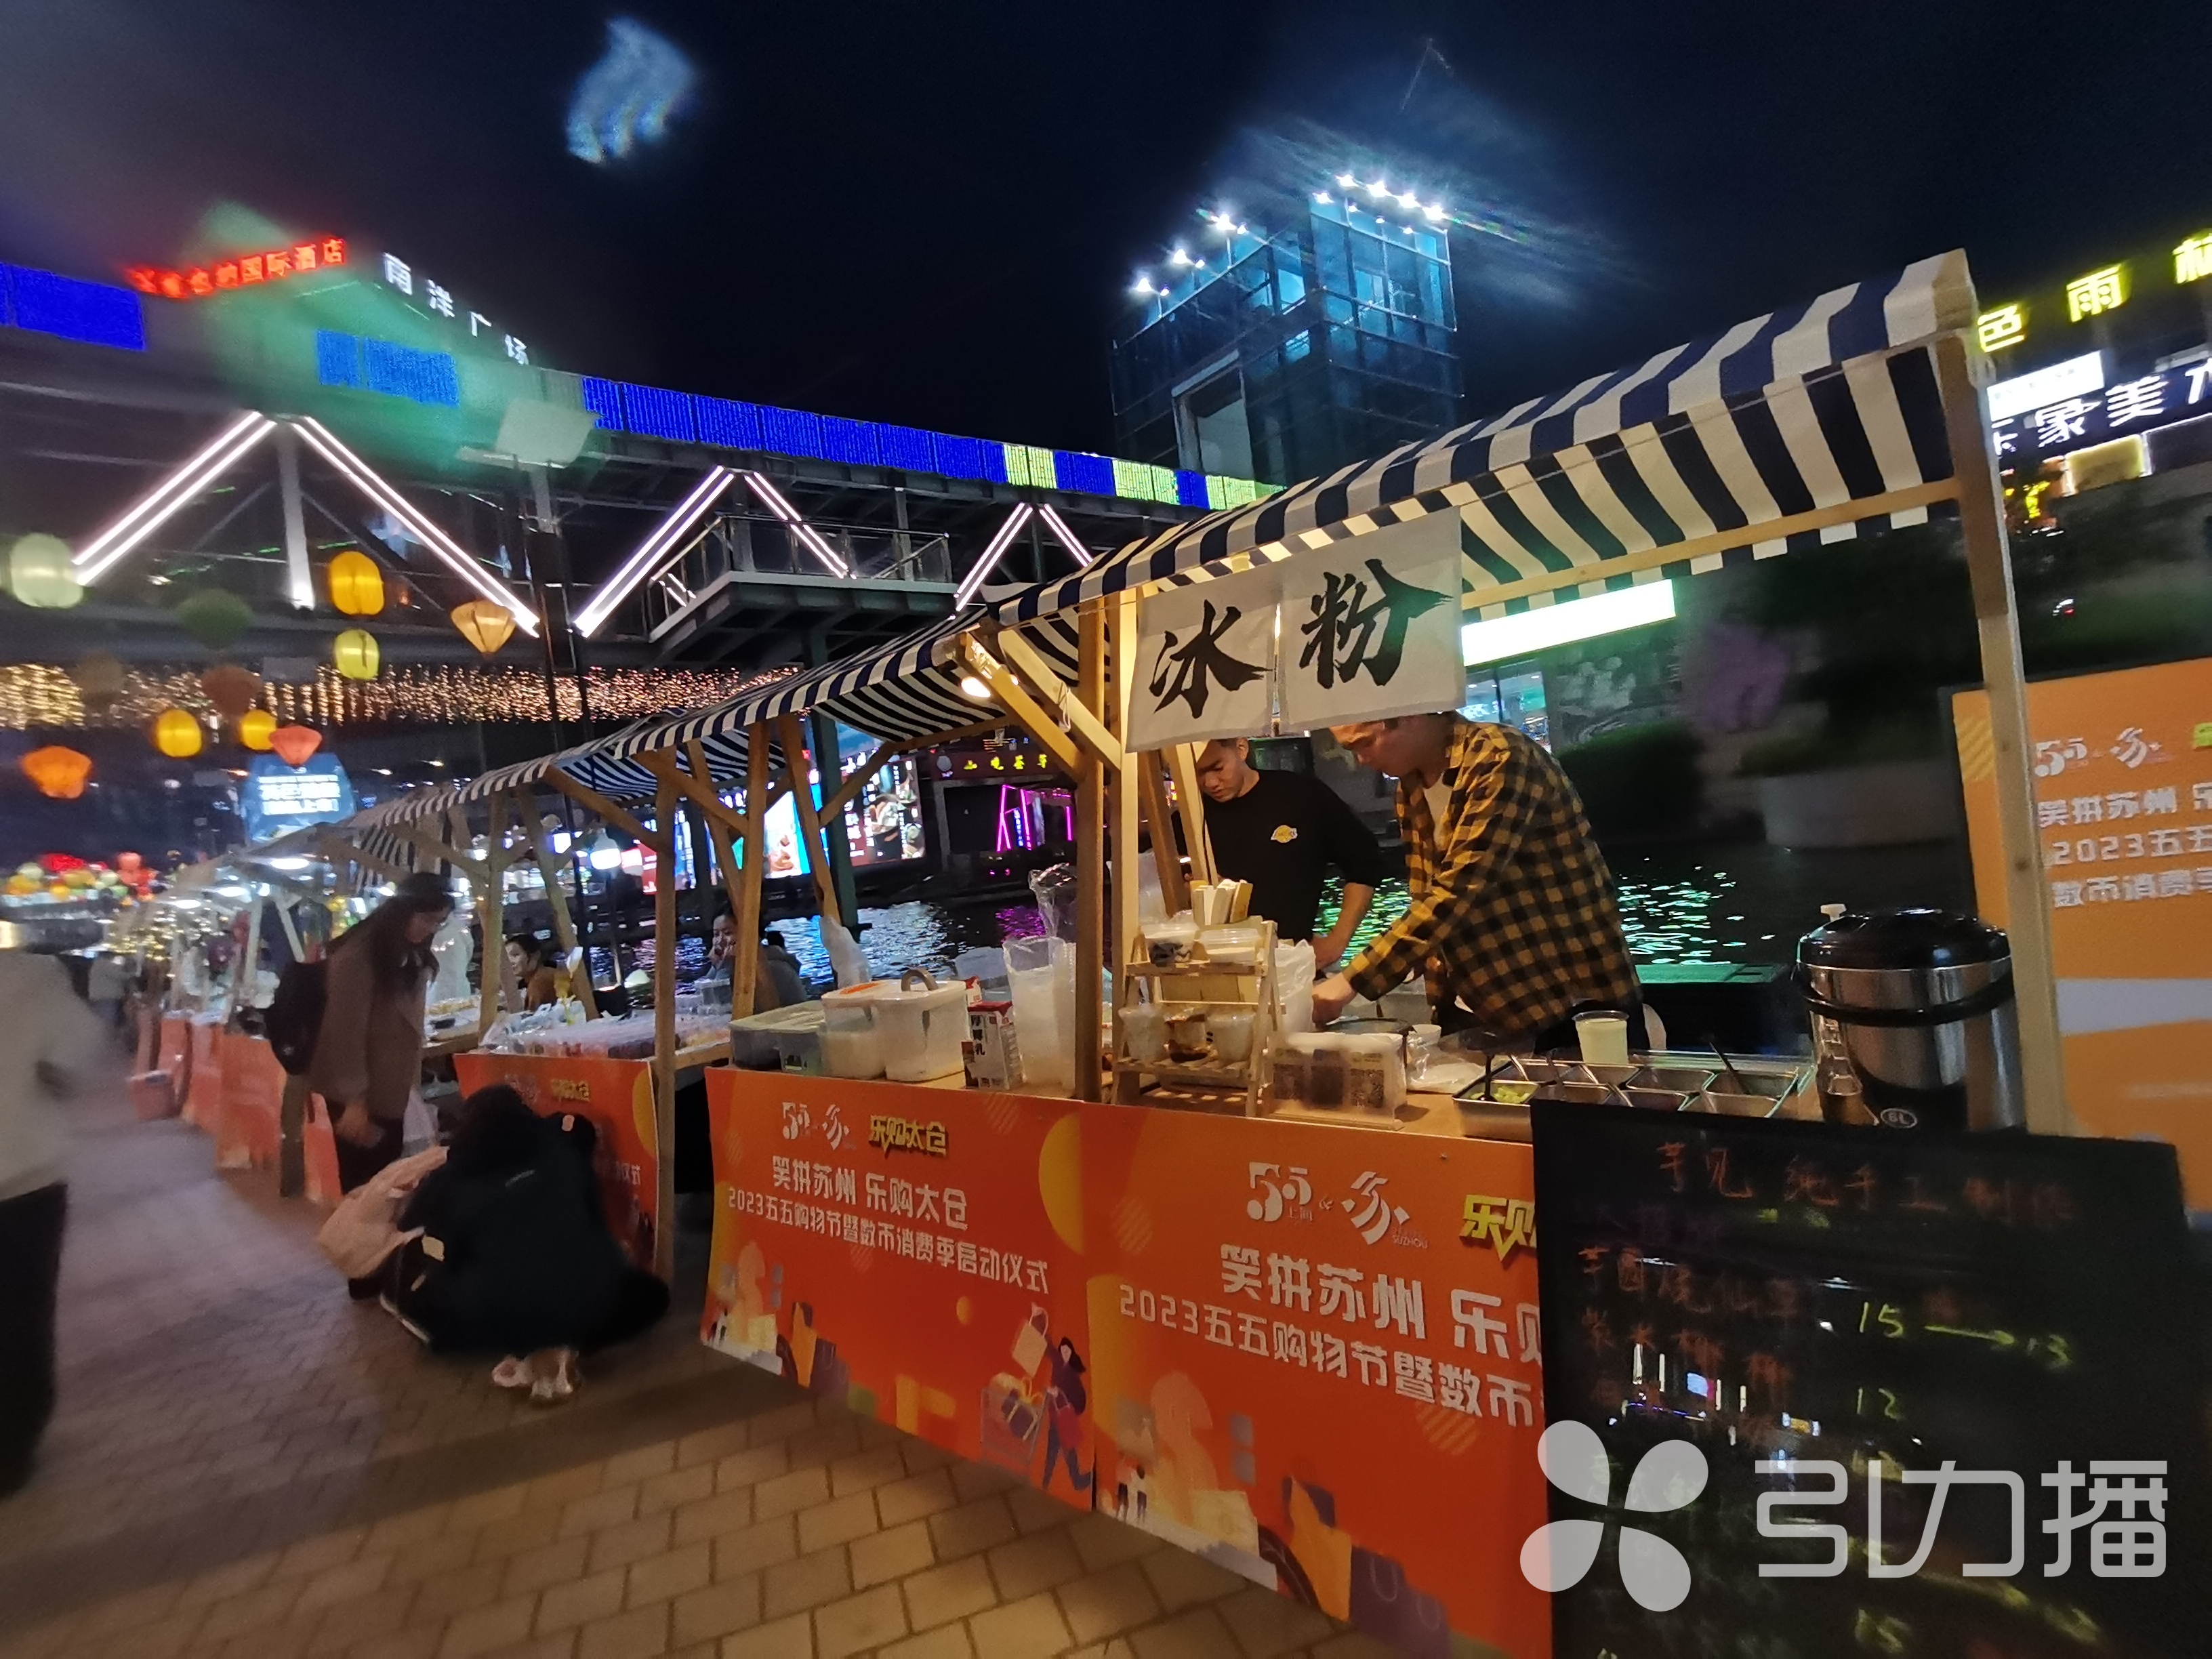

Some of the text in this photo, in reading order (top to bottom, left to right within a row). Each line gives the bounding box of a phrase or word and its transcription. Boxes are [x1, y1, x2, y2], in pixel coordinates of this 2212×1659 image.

[1148, 558, 1455, 719] 冰粉
[773, 1155, 968, 1231] 笑拼苏州 乐购太仓
[1220, 1243, 1427, 1341] 笑拼苏州
[1858, 1301, 1904, 1338] 15
[1856, 1387, 1903, 1420] 12
